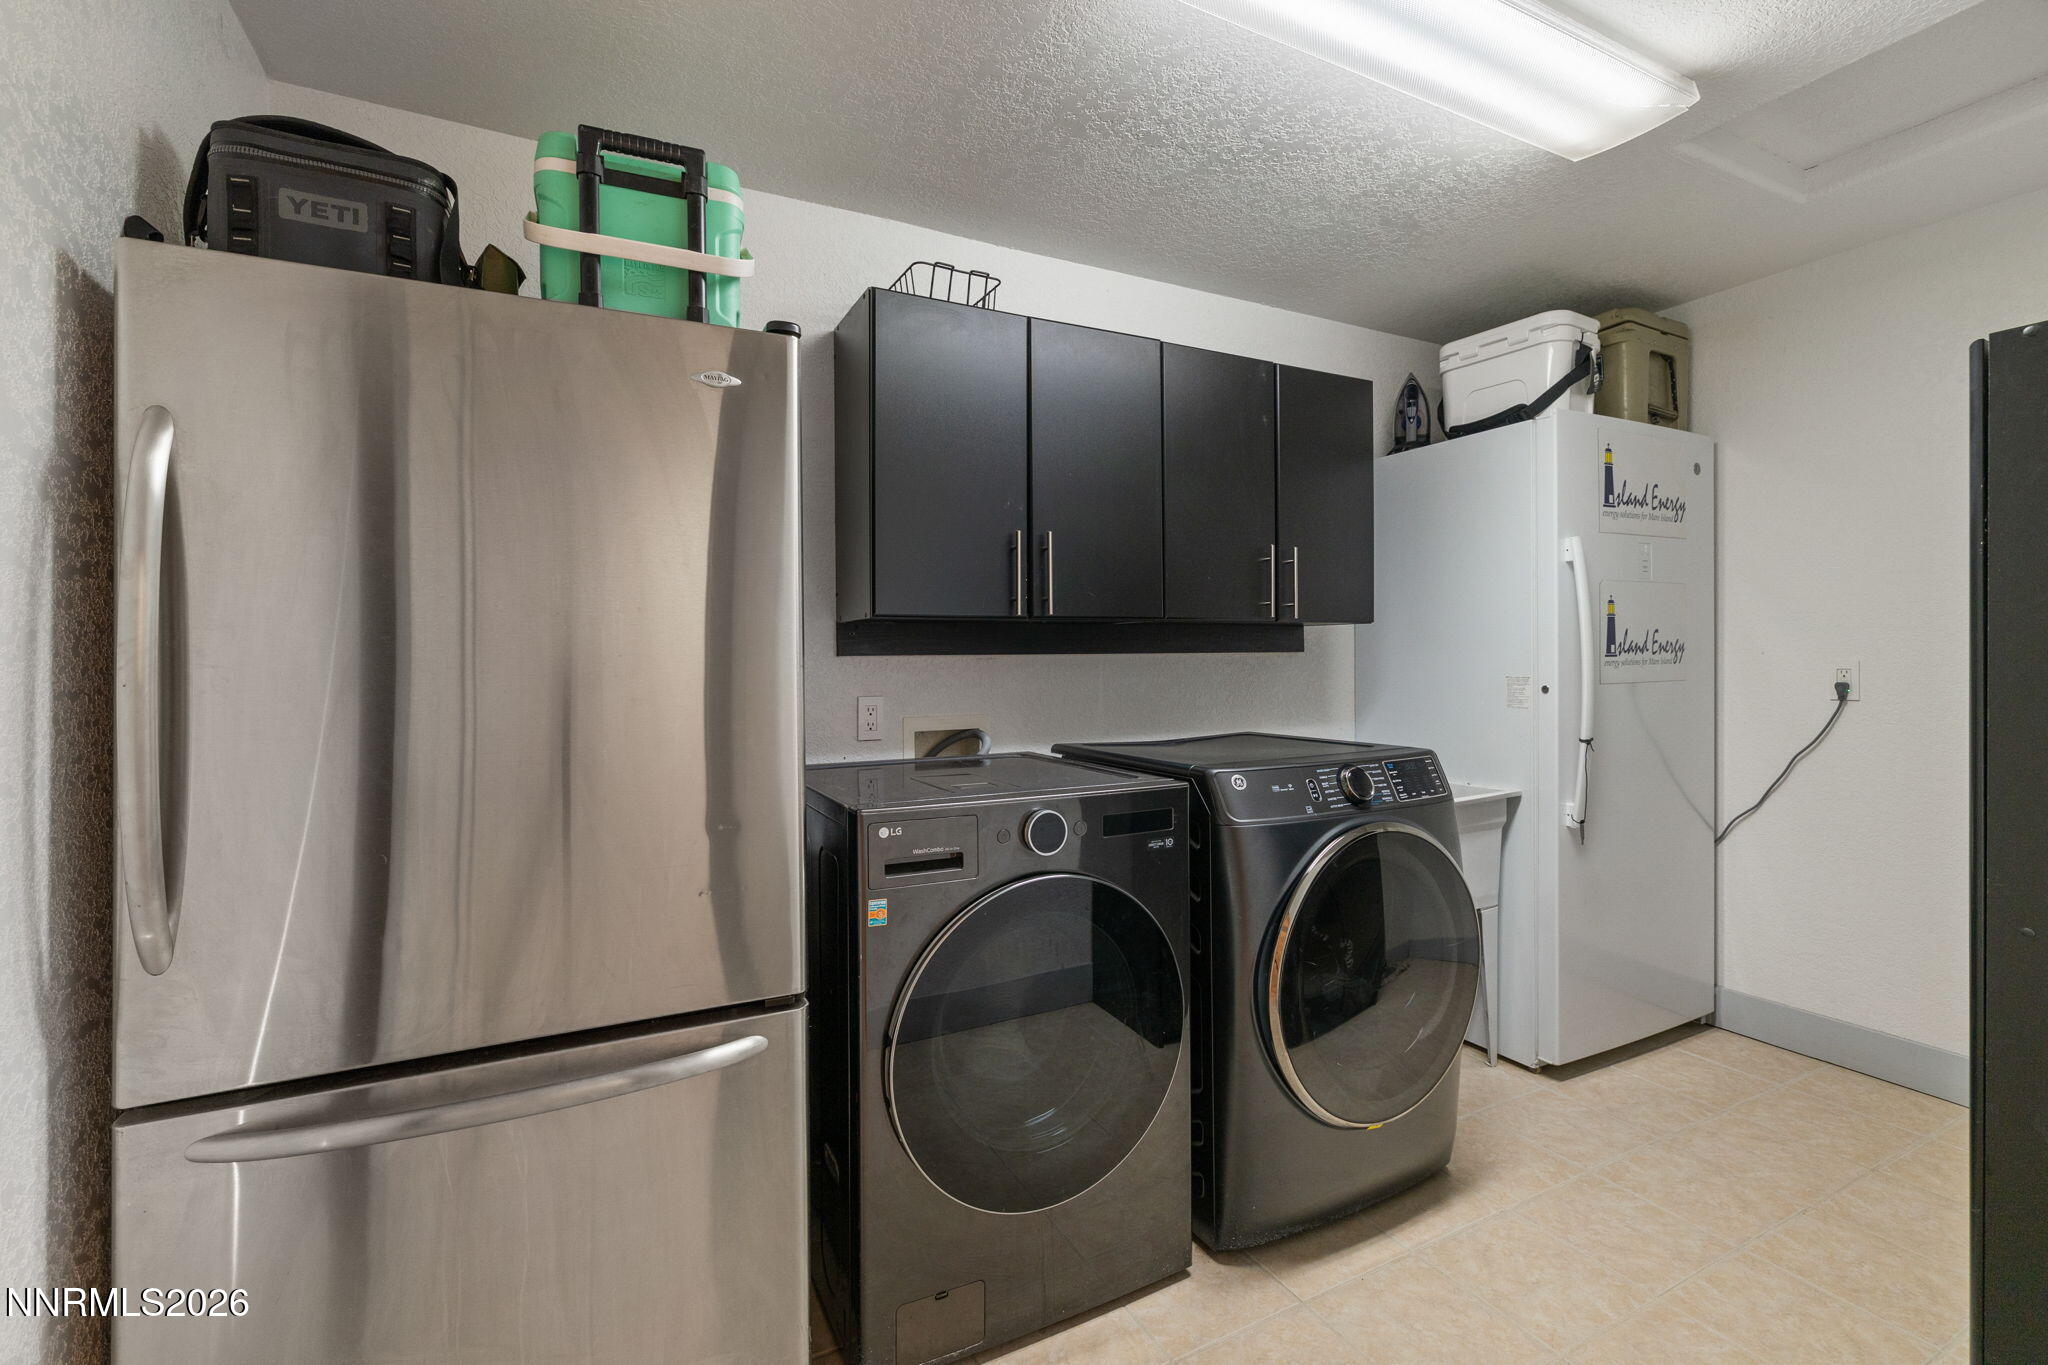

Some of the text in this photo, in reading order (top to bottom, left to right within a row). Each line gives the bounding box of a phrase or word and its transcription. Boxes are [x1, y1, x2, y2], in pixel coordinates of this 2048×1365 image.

[286, 194, 360, 226] YETI
[703, 374, 729, 382] MAYTAG
[1652, 484, 1687, 523] Energy
[1602, 510, 1619, 520] energy
[1619, 510, 1641, 519] solutions
[1640, 511, 1649, 521] for
[1660, 513, 1674, 522] Island
[1652, 628, 1686, 665] Energy
[1603, 659, 1620, 668] energy
[1620, 659, 1641, 667] solutions
[1640, 658, 1649, 667] for
[1660, 656, 1673, 665] Island
[890, 827, 903, 836] LG
